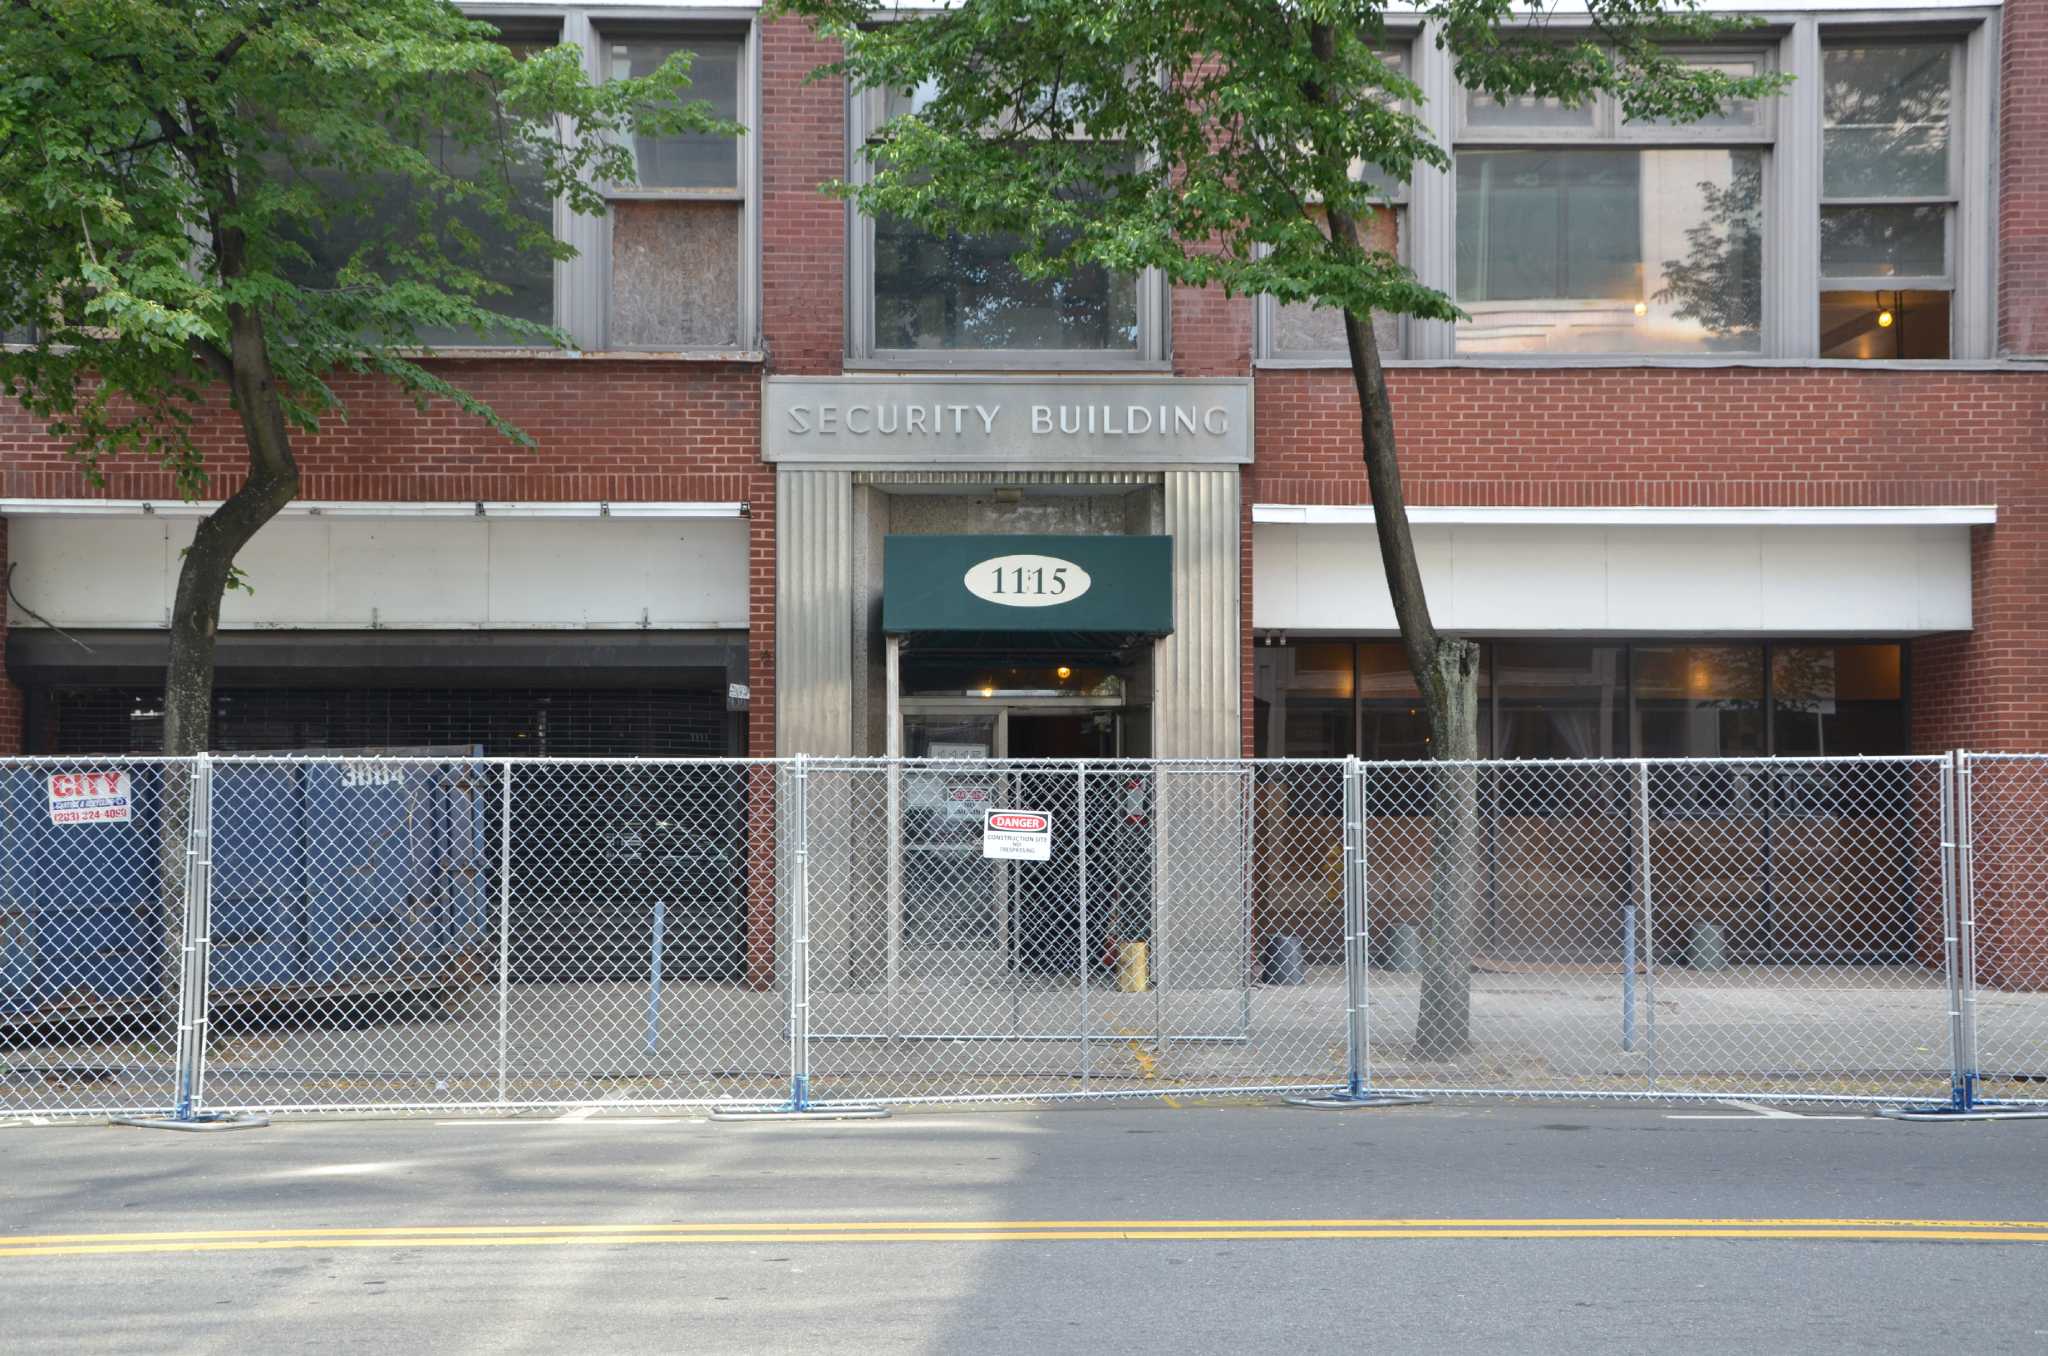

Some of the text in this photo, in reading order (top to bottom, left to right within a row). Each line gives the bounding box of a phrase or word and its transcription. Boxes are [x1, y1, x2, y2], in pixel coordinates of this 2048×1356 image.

[786, 404, 1229, 436] SECURITY BUILDING
[991, 566, 1068, 596] 1115
[52, 771, 121, 798] CITY
[996, 817, 1040, 828] DANGER
